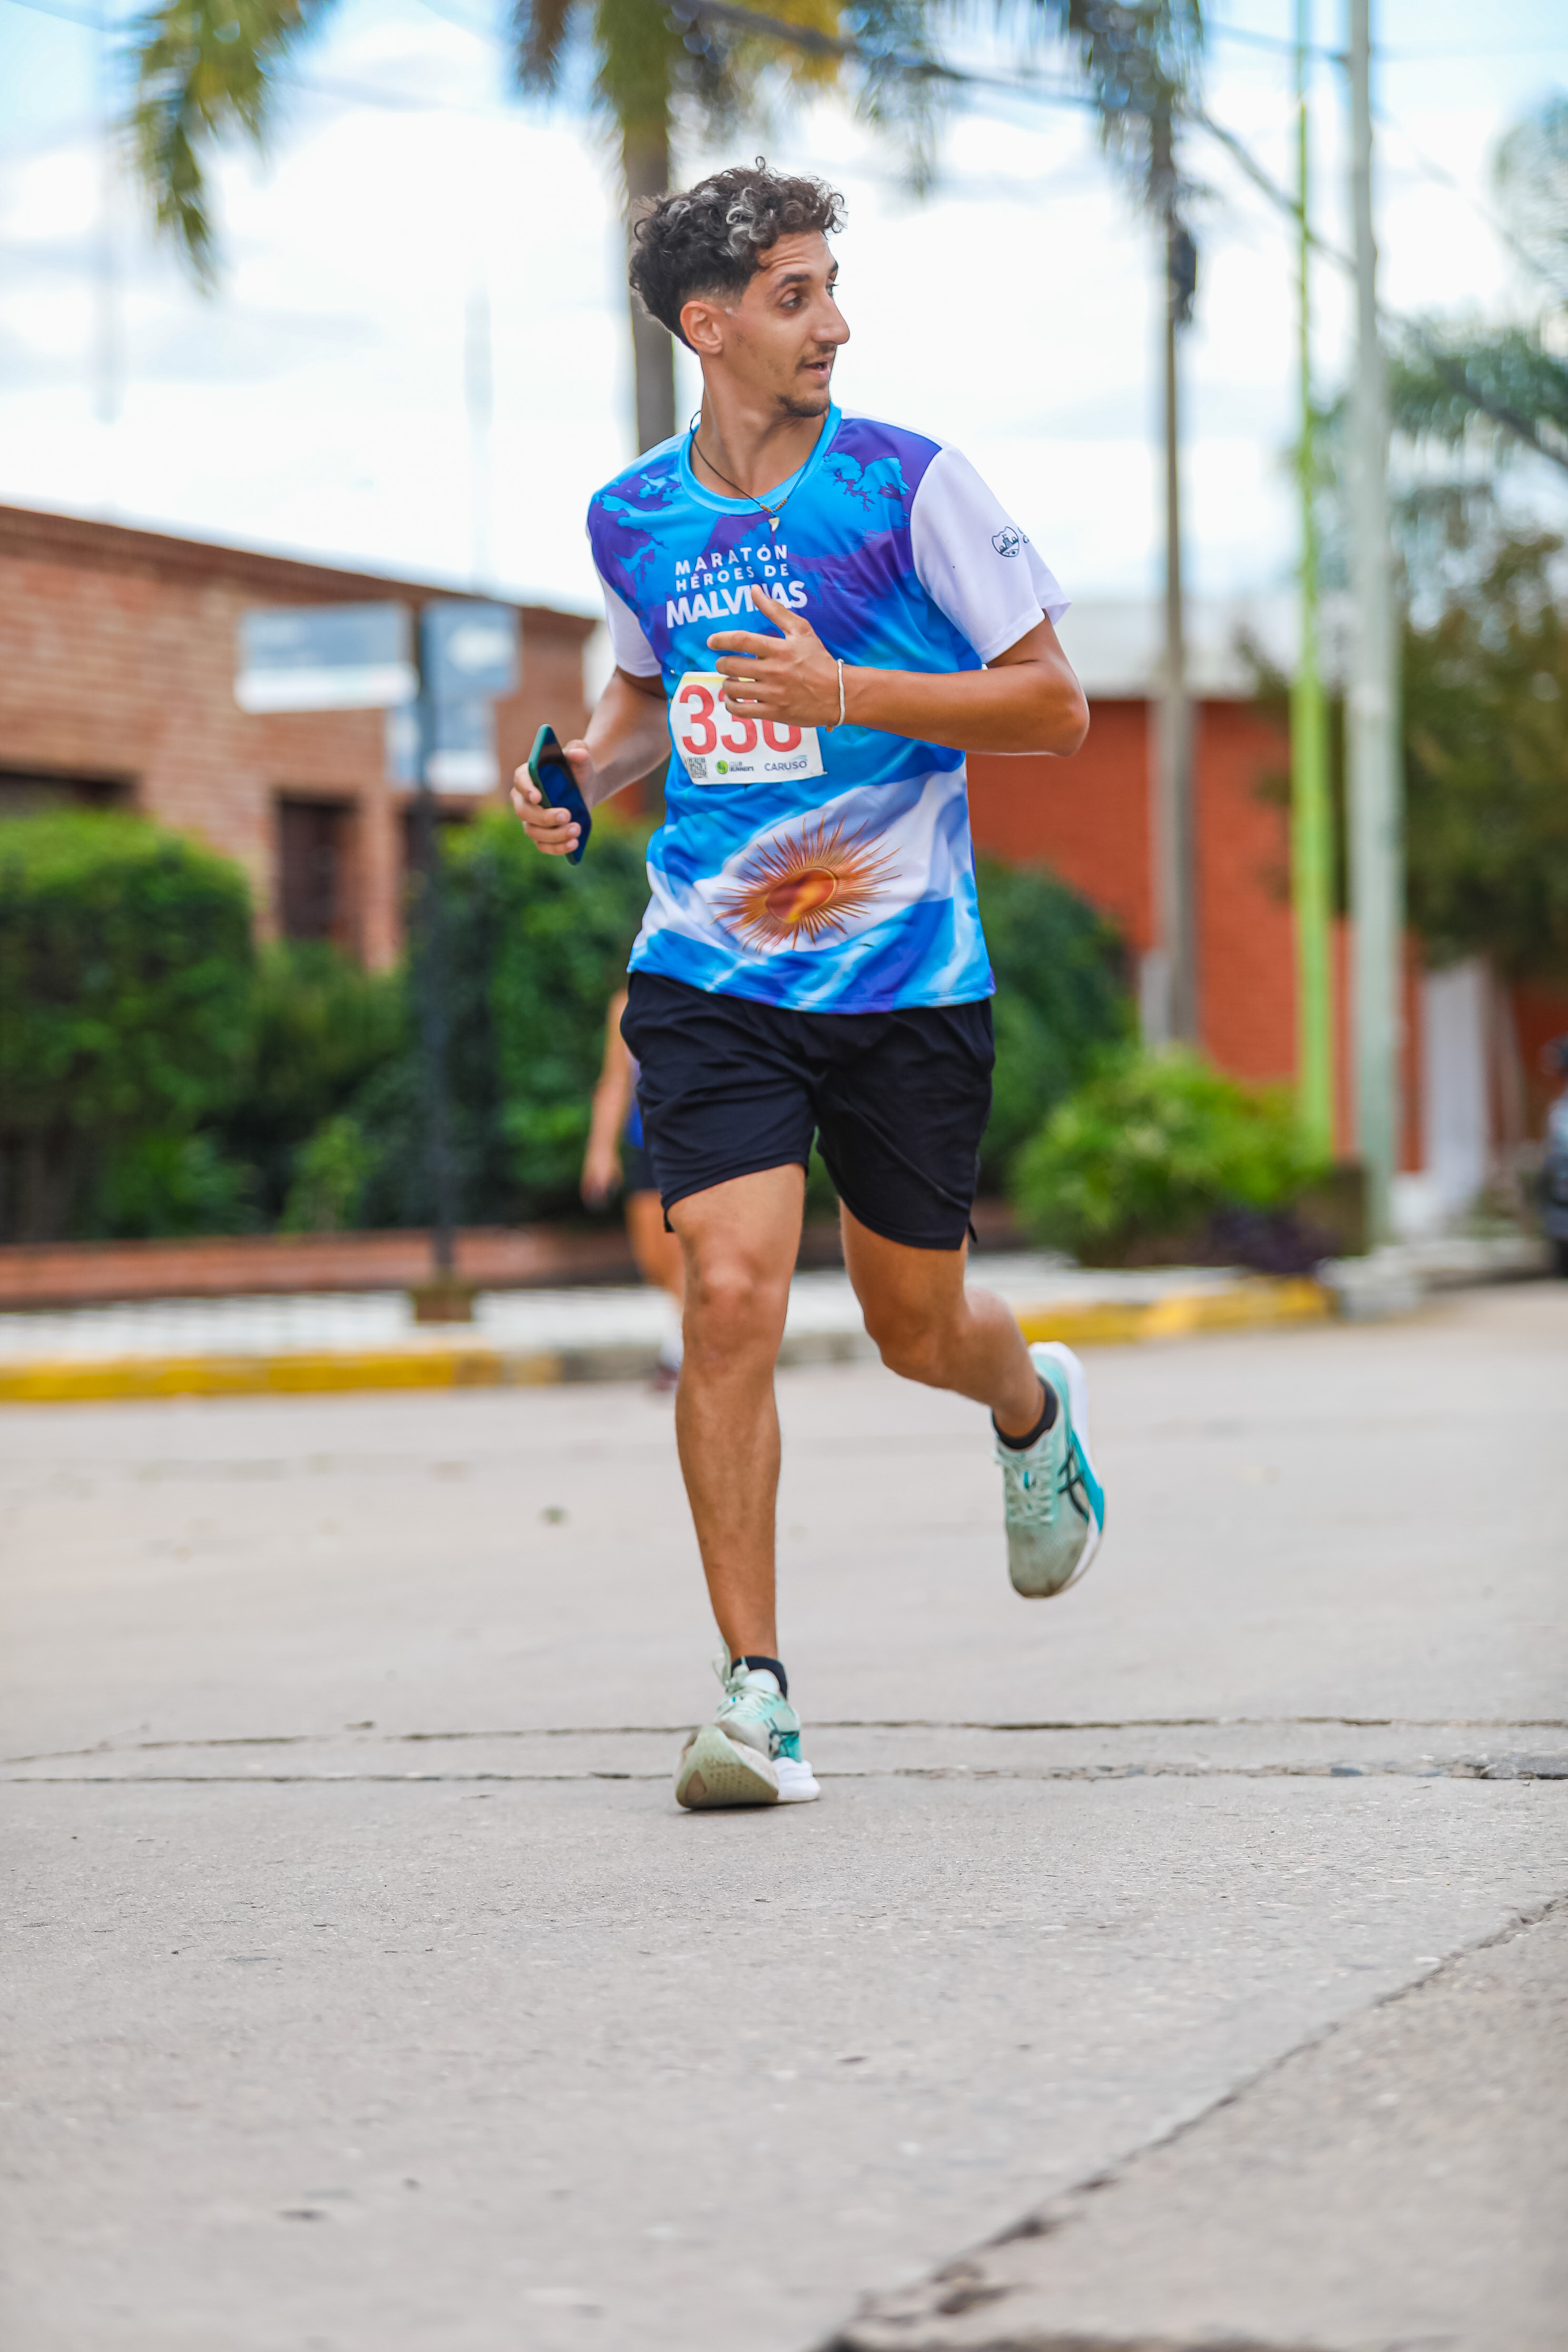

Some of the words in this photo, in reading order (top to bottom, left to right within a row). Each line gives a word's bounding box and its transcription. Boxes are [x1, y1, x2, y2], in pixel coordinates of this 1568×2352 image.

[675, 544, 787, 575] MARATÓN
[676, 566, 754, 592] HÉROES
[764, 563, 789, 577] DE
[764, 760, 807, 771] CARUSO
